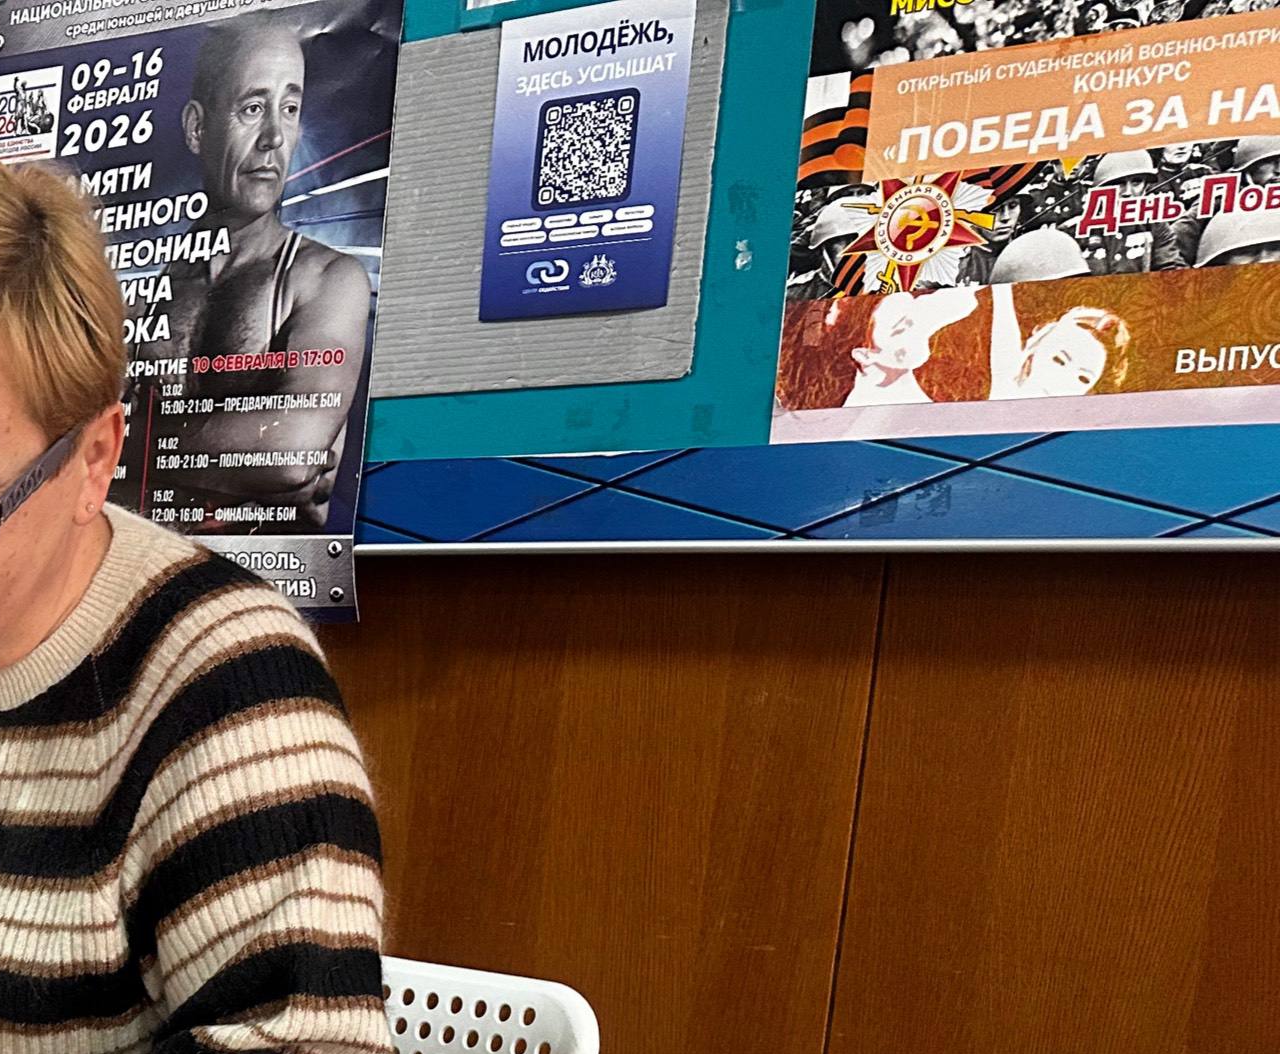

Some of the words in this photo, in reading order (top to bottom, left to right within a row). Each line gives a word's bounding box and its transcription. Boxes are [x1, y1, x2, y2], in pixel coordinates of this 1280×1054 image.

[10, 0, 135, 25] НАЦИОНАЛЬНО
[65, 20, 104, 39] среди
[107, 6, 162, 30] юношей
[164, 8, 174, 20] и
[175, 0, 236, 20] девушек
[523, 18, 675, 63] МОЛОДЁЖЬ,
[71, 48, 164, 91] 09-16
[515, 70, 573, 97] ЗДЕСЬ
[577, 52, 678, 86] УСЛЫШАТ
[897, 65, 991, 95] ОТКРЫТЫЙ
[996, 43, 1134, 81] СТУДЕНЧЕСКИЙ
[1073, 60, 1192, 94] КОНКУРС
[66, 79, 160, 114] ФЕВРАЛЯ
[60, 110, 154, 157] 2026
[884, 102, 1105, 164] «ПОБЕДА
[1121, 95, 1189, 136] ЗА
[70, 162, 153, 198] МЯТИ
[96, 192, 209, 233] ЕННОГО
[121, 275, 173, 306] ИЧА
[123, 314, 171, 344] ОКА
[192, 356, 210, 373] 10
[212, 352, 286, 373] ФЕВРАЛЯ
[287, 351, 300, 367] В
[302, 348, 345, 367] 17:00
[160, 398, 214, 415] 15:00-21:00
[320, 392, 342, 408] БОИ
[162, 384, 183, 397] 13.02
[156, 454, 209, 469] 15:00-21:00
[219, 451, 306, 468] ПОЛУФИНАЛЬНЫЕ
[307, 450, 328, 465] БОИ
[157, 437, 179, 450] 14.02
[153, 490, 174, 503] 15.02
[151, 507, 204, 522] 12:00-16:00
[214, 506, 274, 521] ФИНАЛЬНЫЕ
[276, 506, 297, 521] БОИ
